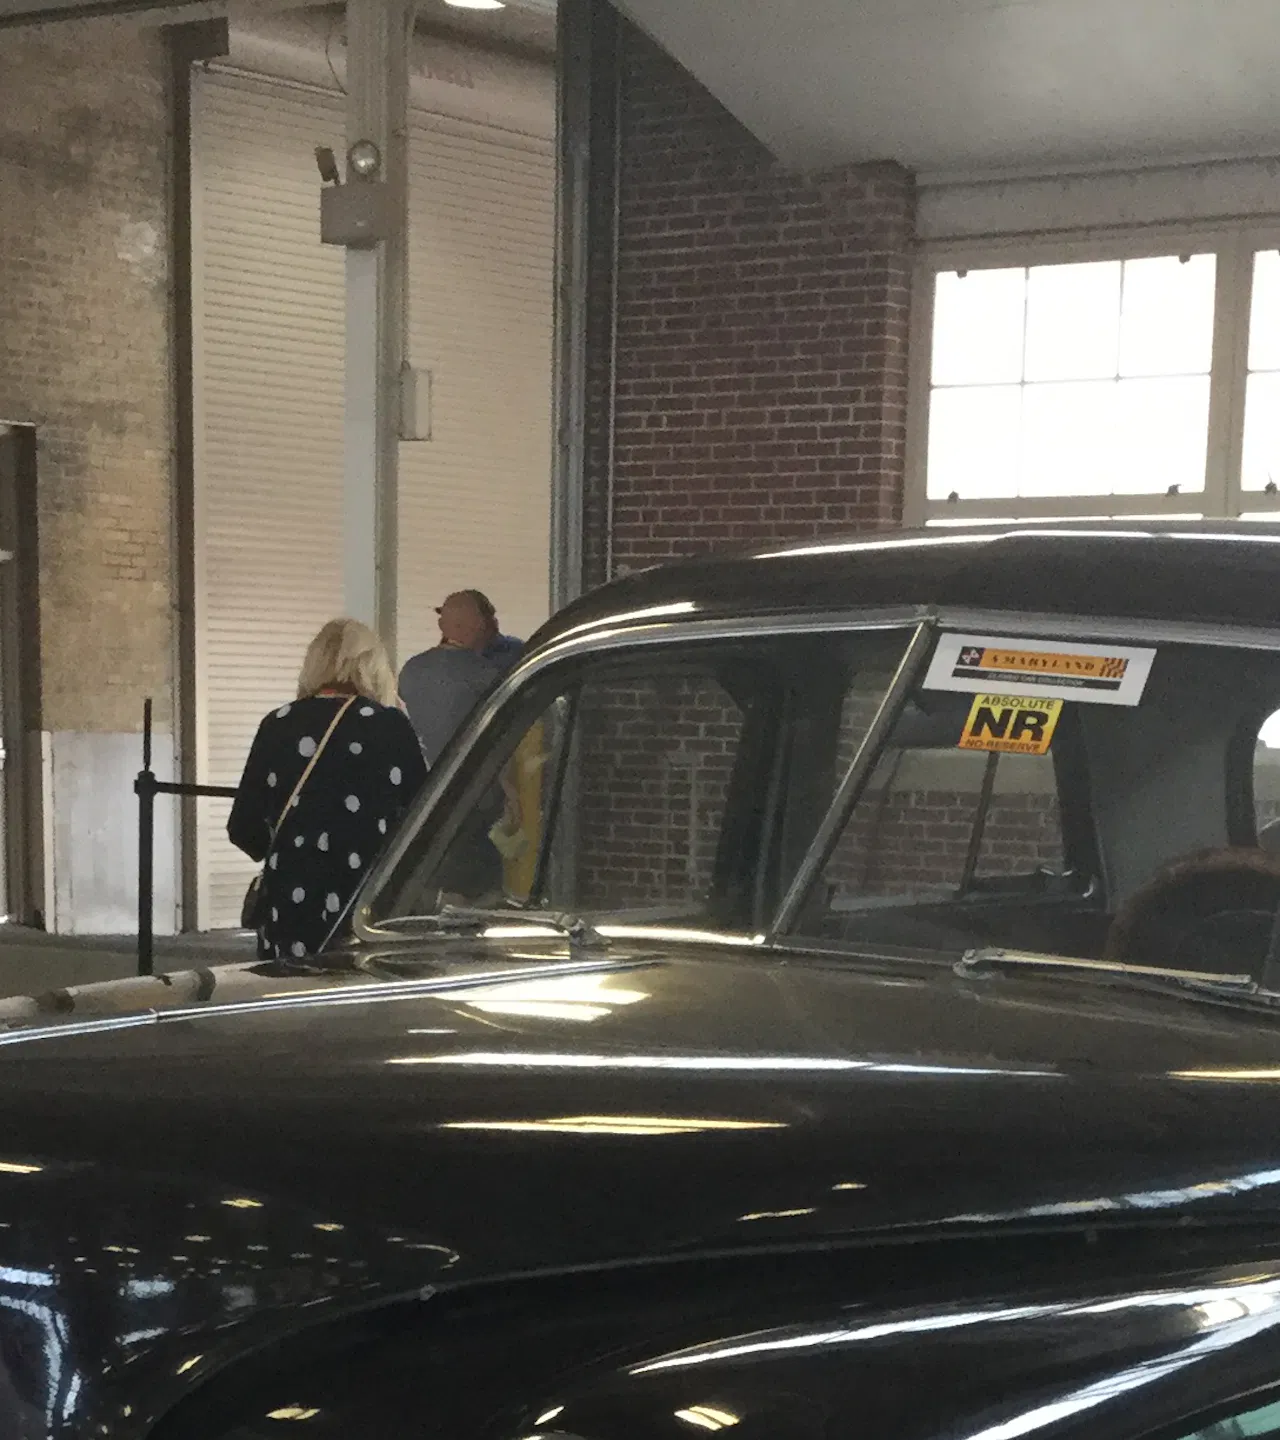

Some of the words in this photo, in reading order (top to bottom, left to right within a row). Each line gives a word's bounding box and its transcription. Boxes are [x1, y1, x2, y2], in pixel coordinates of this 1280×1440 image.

[980, 695, 1055, 710] ABSOLUTE
[969, 706, 1050, 742] NR
[965, 738, 984, 749] NO
[986, 740, 1041, 753] RESERVE
